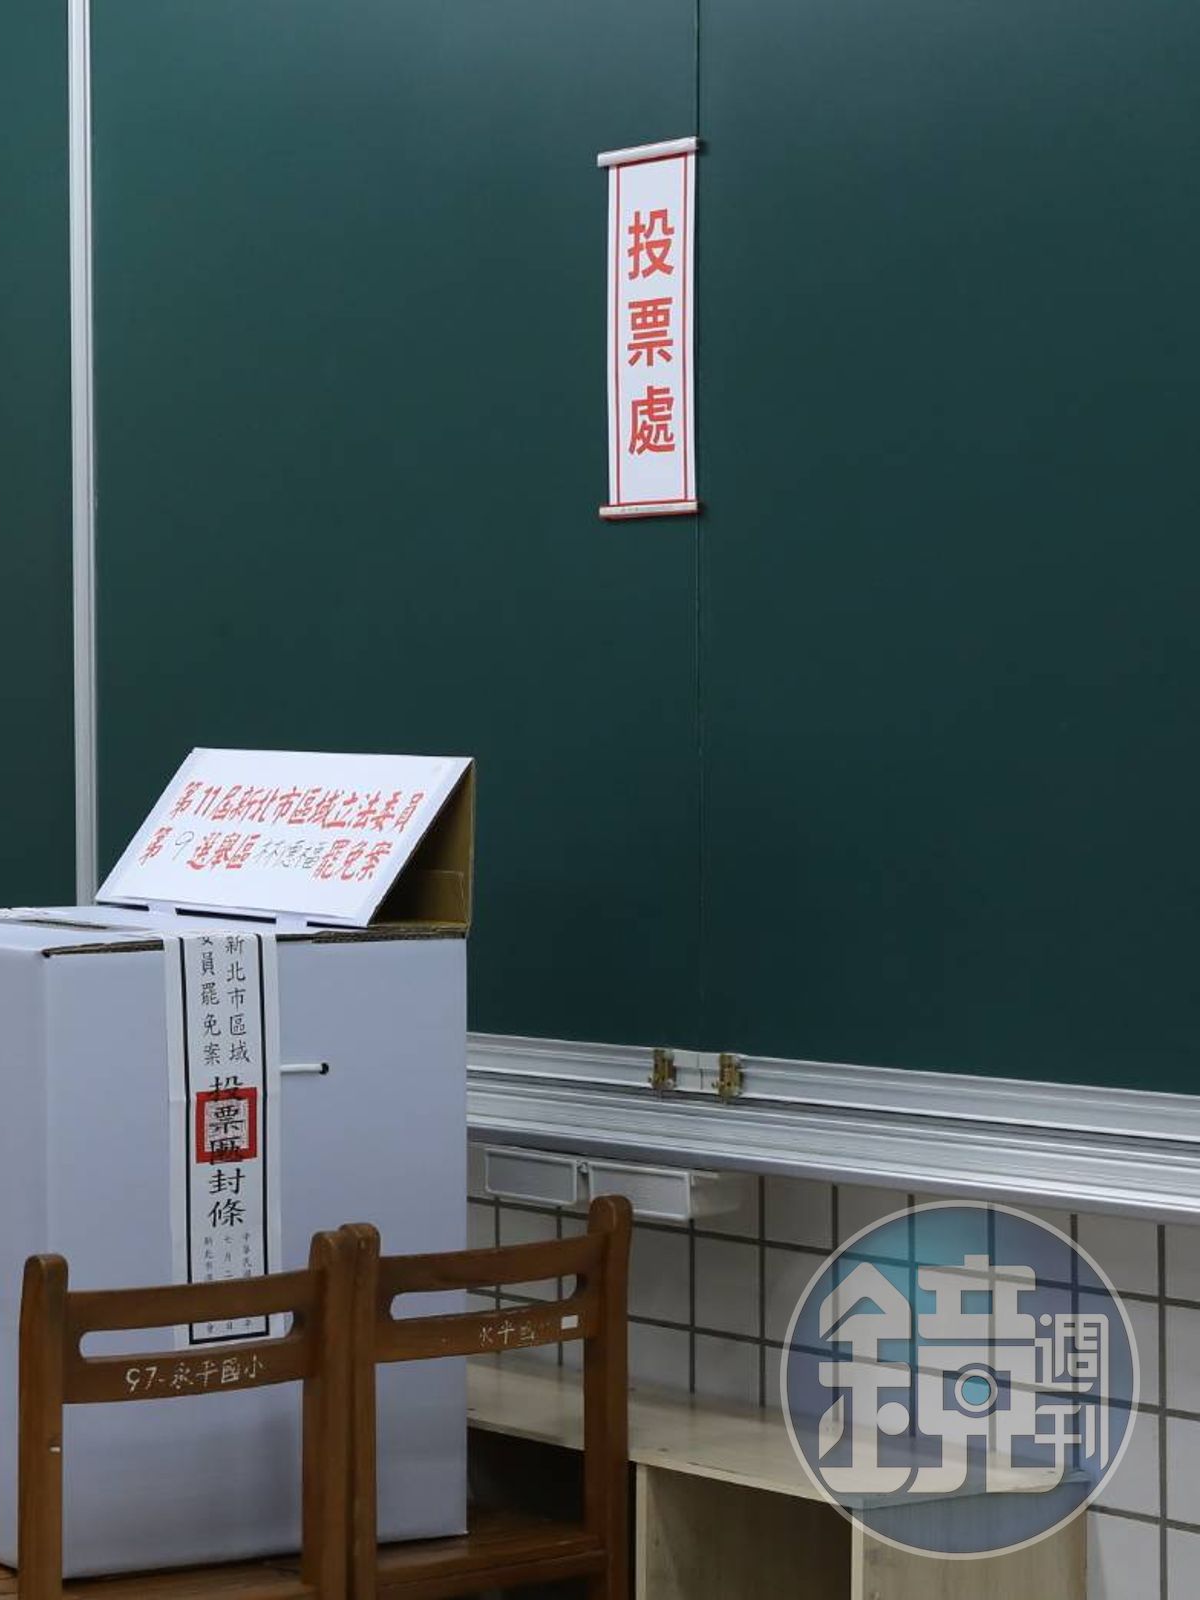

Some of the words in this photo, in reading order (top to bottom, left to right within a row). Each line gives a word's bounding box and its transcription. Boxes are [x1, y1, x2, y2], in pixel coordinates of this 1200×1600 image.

[627, 208, 676, 455] 投票處
[225, 935, 250, 1064] 新北市區域
[208, 1075, 246, 1229] 投票匭封條
